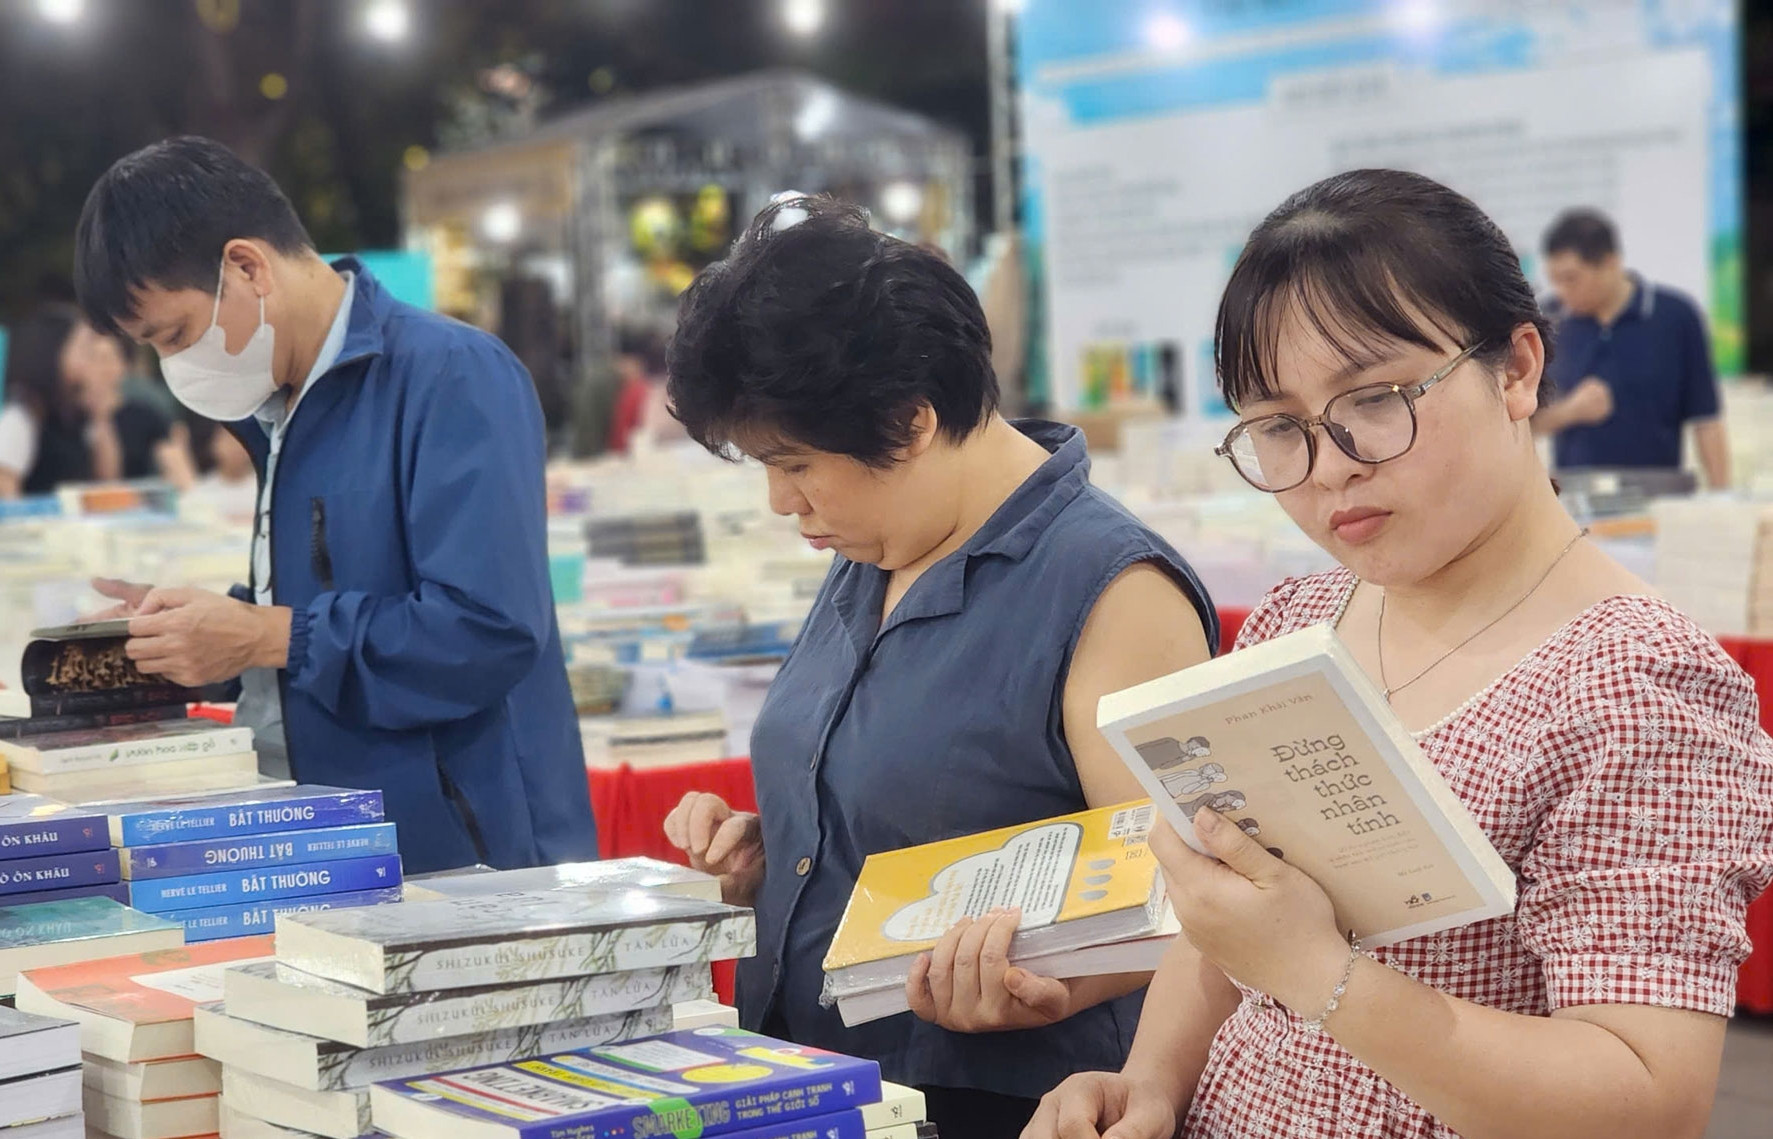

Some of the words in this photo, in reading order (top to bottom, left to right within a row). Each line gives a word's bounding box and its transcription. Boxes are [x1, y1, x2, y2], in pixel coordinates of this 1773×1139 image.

[1270, 734, 1346, 763] Đừng
[1284, 752, 1360, 782] thách
[1314, 774, 1372, 798] thức
[1320, 794, 1387, 820] nhân
[1347, 811, 1400, 835] tính
[187, 886, 197, 897] LE
[198, 883, 227, 896] TELLIER
[271, 870, 331, 889] THƯỜNG
[758, 1090, 780, 1104] PHÁP
[782, 1088, 804, 1101] CANH
[806, 1083, 833, 1096] TRANH
